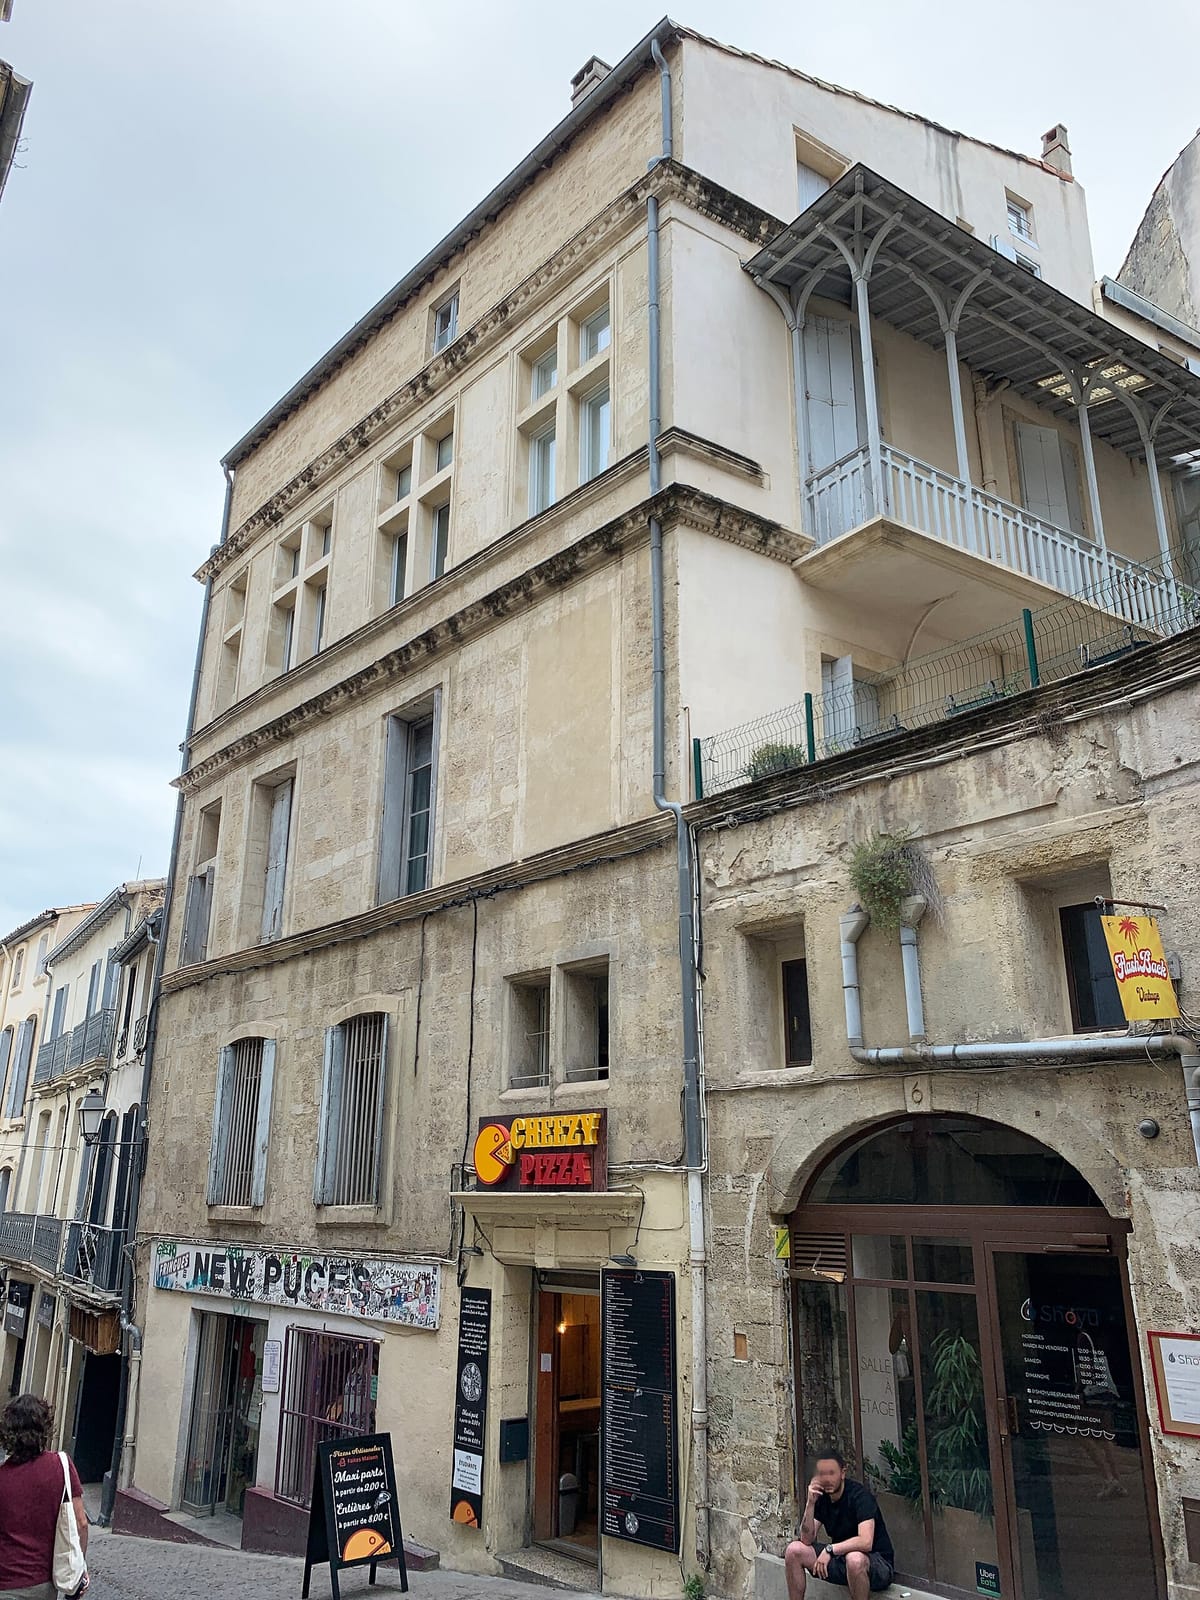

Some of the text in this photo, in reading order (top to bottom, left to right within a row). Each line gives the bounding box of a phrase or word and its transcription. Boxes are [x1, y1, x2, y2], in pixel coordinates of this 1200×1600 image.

[1136, 986, 1160, 1005] Vintage
[911, 1080, 924, 1105] 6
[510, 1113, 601, 1149] CHEEZY
[520, 1152, 592, 1185] PIZZA
[192, 1252, 371, 1309] NEW PUCES
[860, 1356, 892, 1374] SALLE
[1177, 1353, 1200, 1366] Sho
[334, 1467, 384, 1483] Maxi parts
[340, 1486, 356, 1498] partir
[363, 1481, 379, 1492] 2,00
[336, 1502, 372, 1515] Entières
[343, 1518, 359, 1530] partir
[367, 1512, 384, 1523] 8,00
[979, 1568, 996, 1580] Uber
[980, 1577, 996, 1588] Eats
